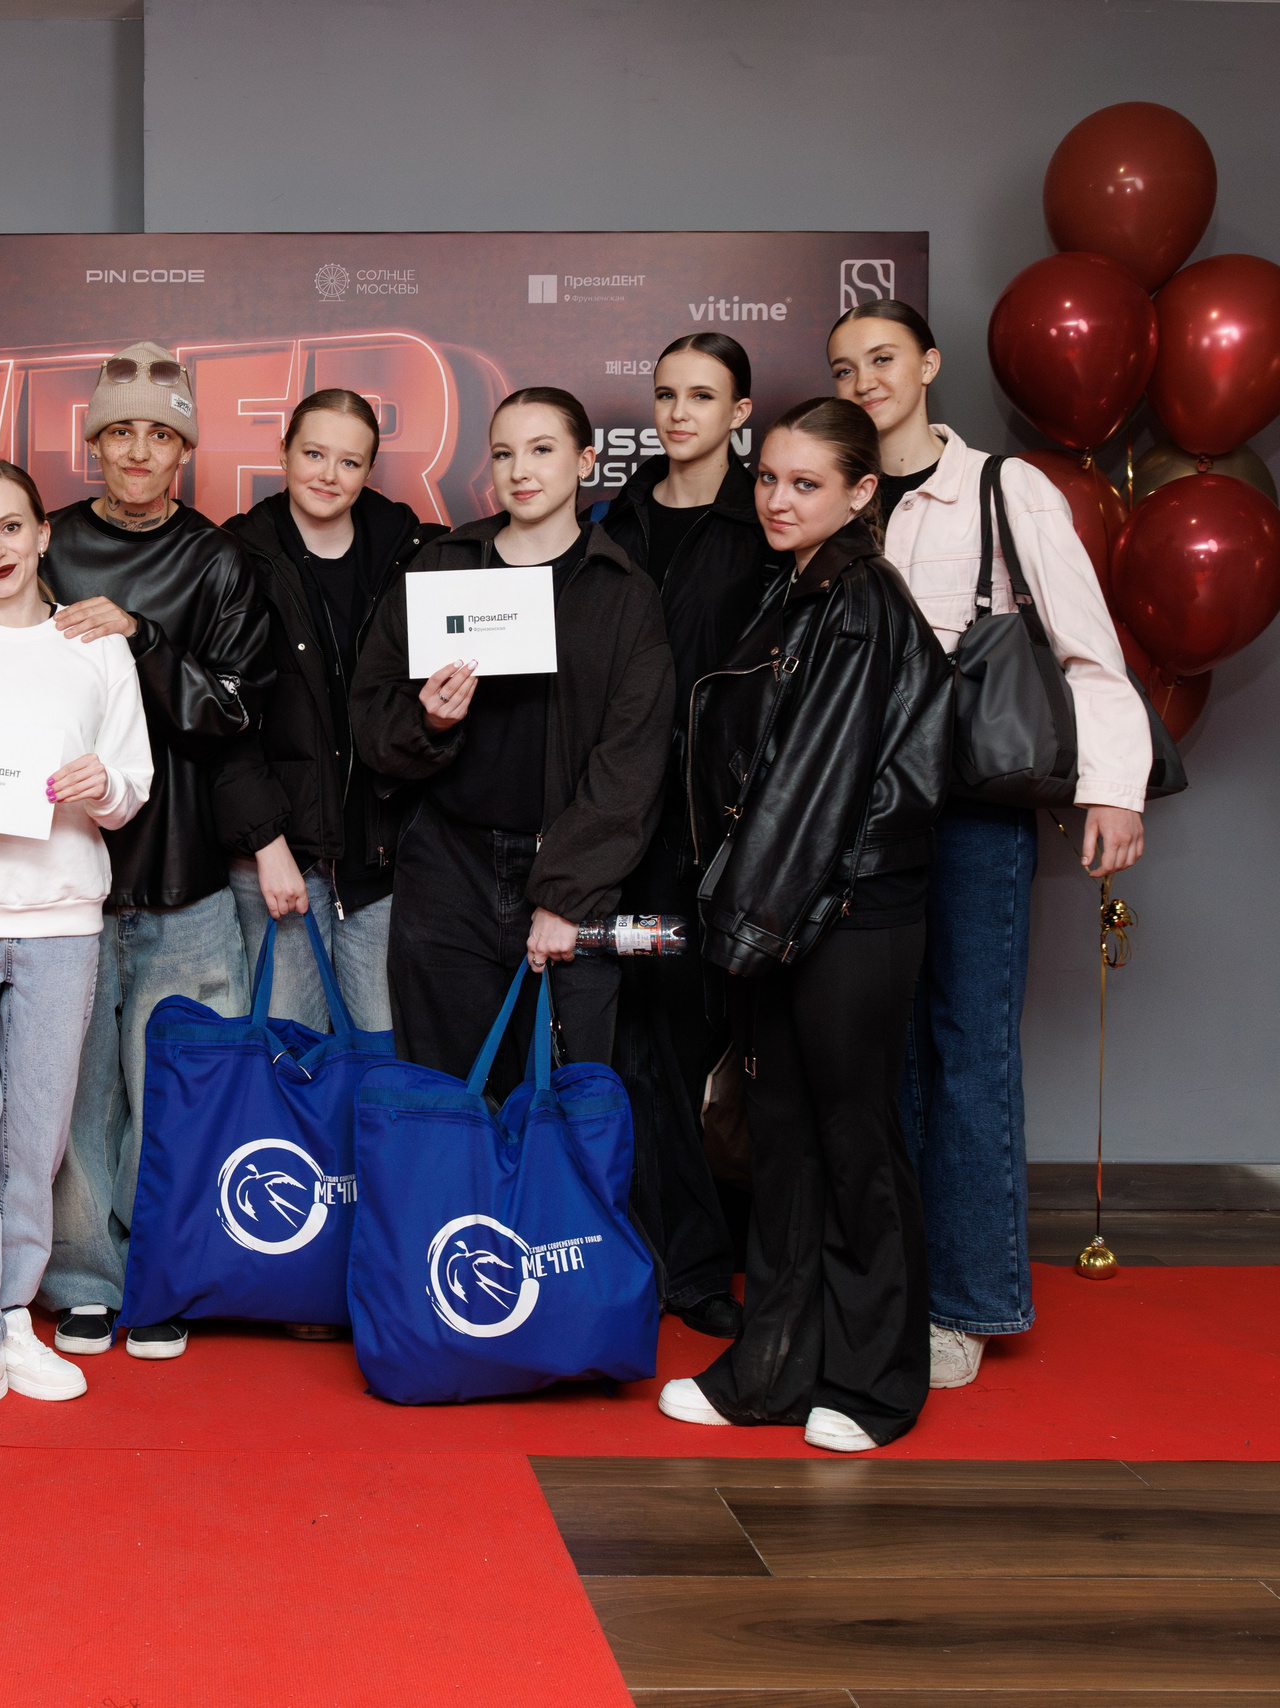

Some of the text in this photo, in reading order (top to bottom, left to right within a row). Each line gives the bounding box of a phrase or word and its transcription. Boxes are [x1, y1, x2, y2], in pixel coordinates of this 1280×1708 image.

[86, 269, 205, 283] PIN CODE
[356, 269, 416, 282] СОЛНЦЕ
[564, 275, 645, 289] ПрезиДЕНТ
[356, 283, 419, 295] МОСКВЫ
[468, 613, 517, 623] ПрезиДЕНТ
[521, 1246, 585, 1279] МЕЧТА
